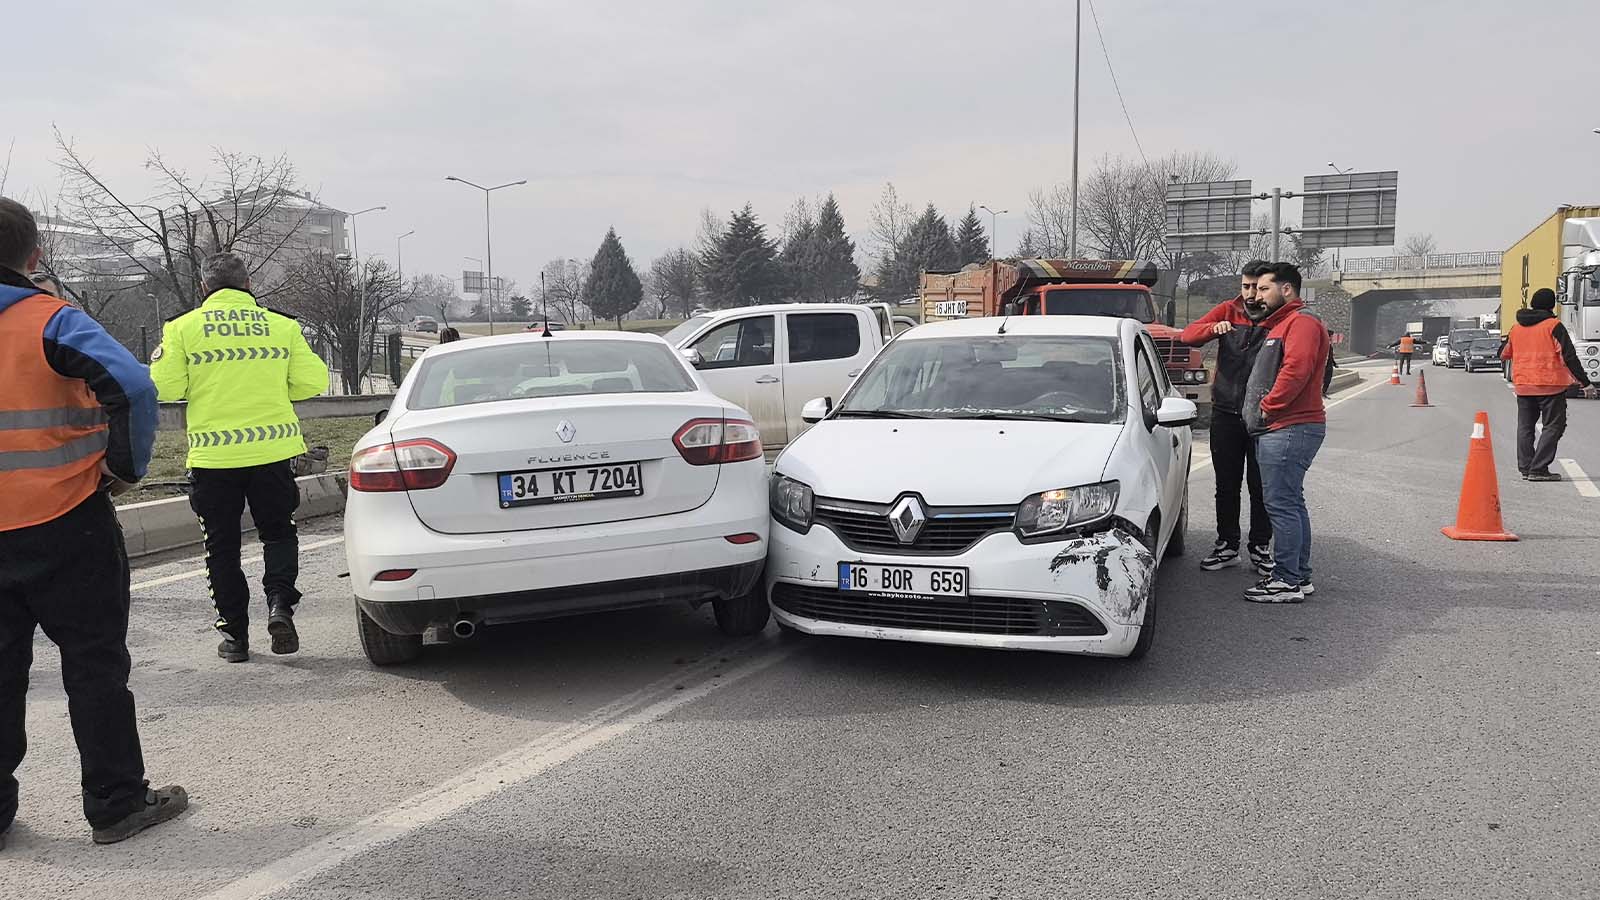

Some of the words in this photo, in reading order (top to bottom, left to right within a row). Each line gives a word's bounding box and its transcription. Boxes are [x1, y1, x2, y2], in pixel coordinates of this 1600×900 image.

[936, 303, 943, 314] 16
[944, 302, 955, 314] JHT
[202, 309, 268, 322] TRAFİK
[203, 323, 270, 337] POLİSİ
[527, 451, 611, 464] FLUENCE
[513, 475, 539, 497] 34
[552, 471, 577, 494] KT
[587, 466, 637, 491] 7204
[851, 567, 868, 588] 16
[881, 568, 913, 591] BOR
[930, 571, 963, 593] 659
